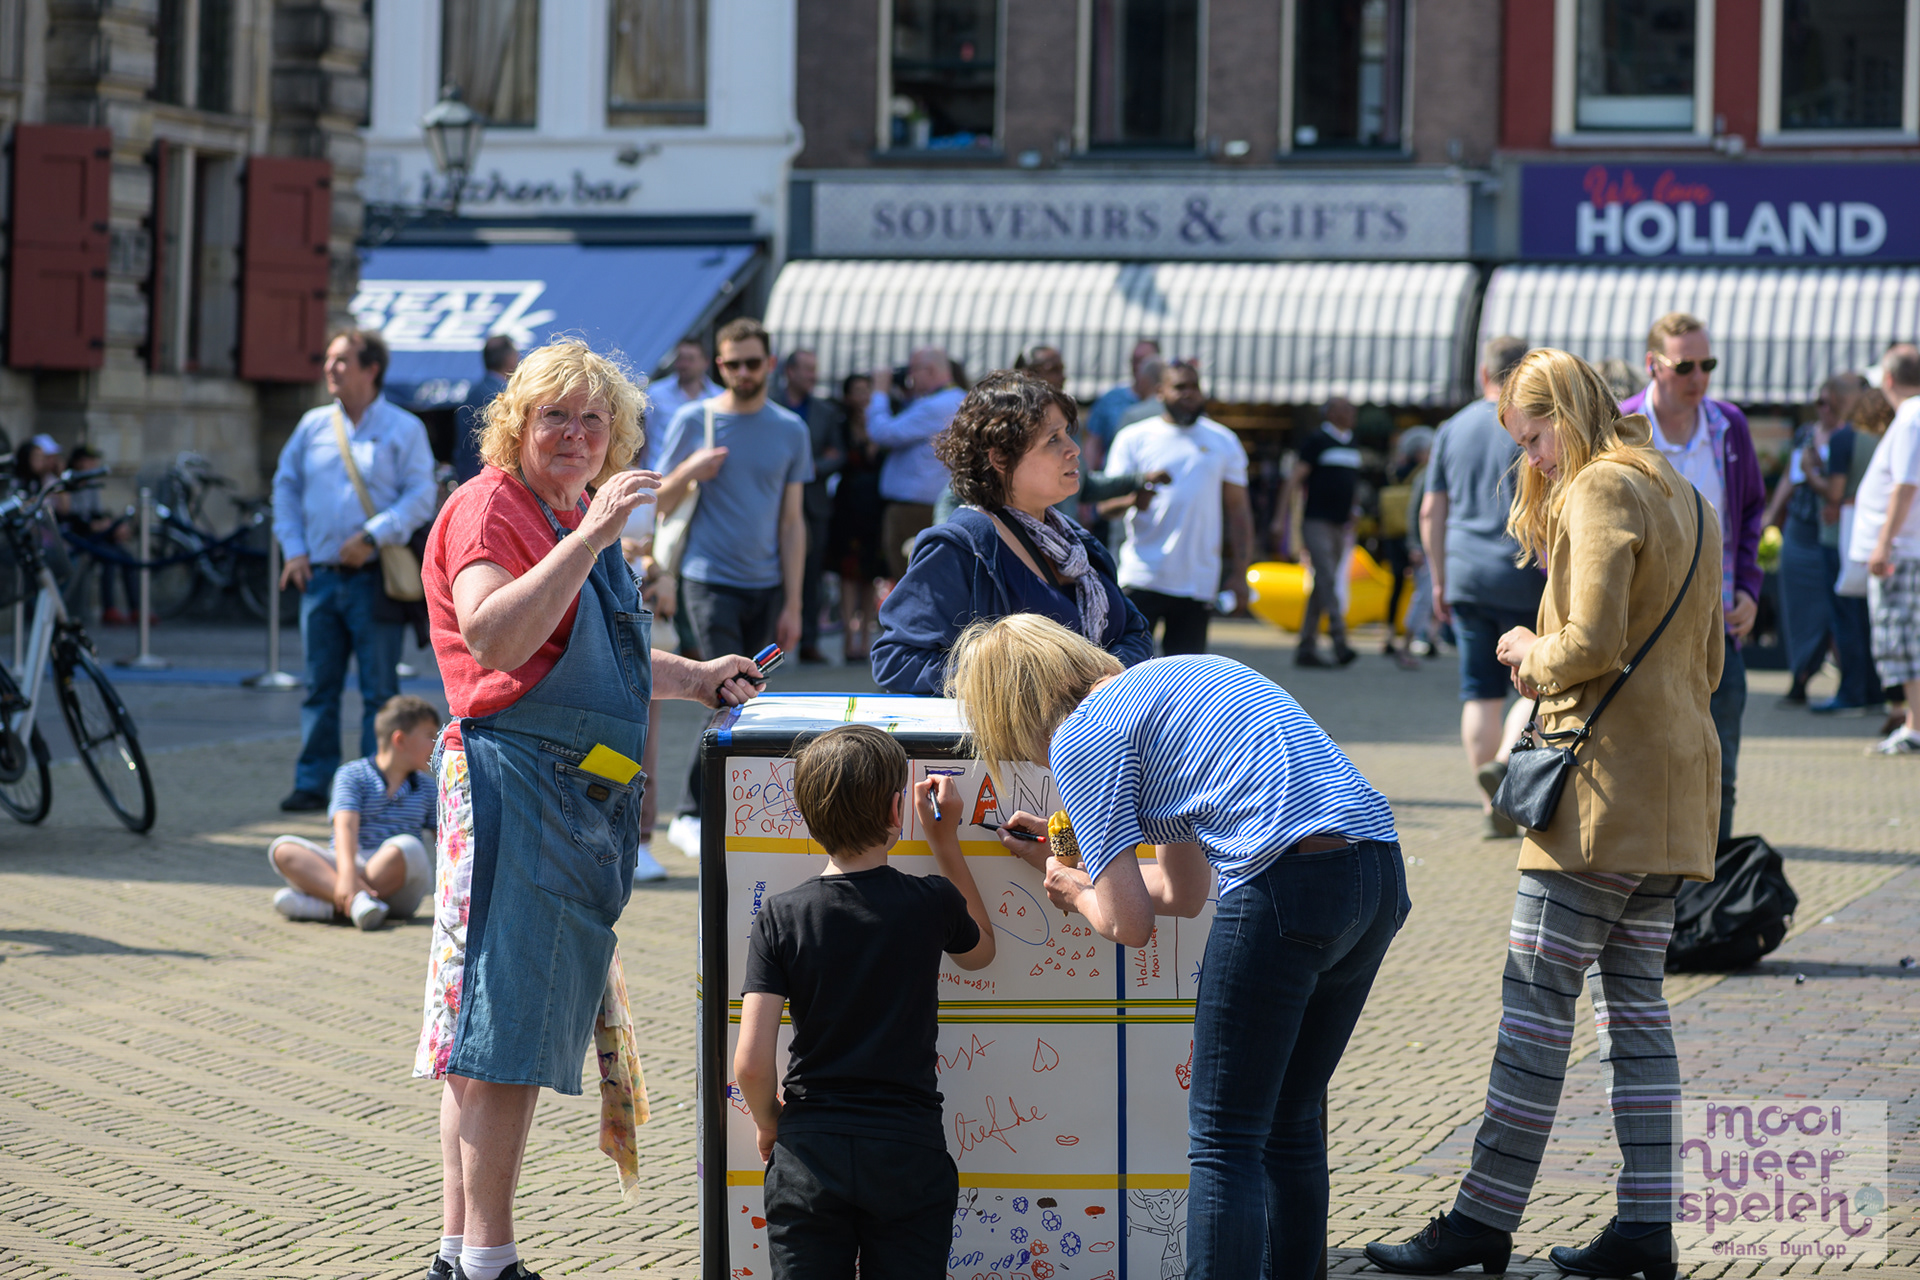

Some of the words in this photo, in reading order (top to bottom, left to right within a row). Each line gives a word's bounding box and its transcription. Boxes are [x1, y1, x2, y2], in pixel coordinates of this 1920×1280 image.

[572, 168, 642, 203] bar
[872, 201, 1160, 242] SOUVENIRS
[1178, 194, 1228, 244] &
[1247, 201, 1408, 242] GIFTS
[1575, 201, 1888, 257] HOLLAND
[349, 286, 502, 315] REAL
